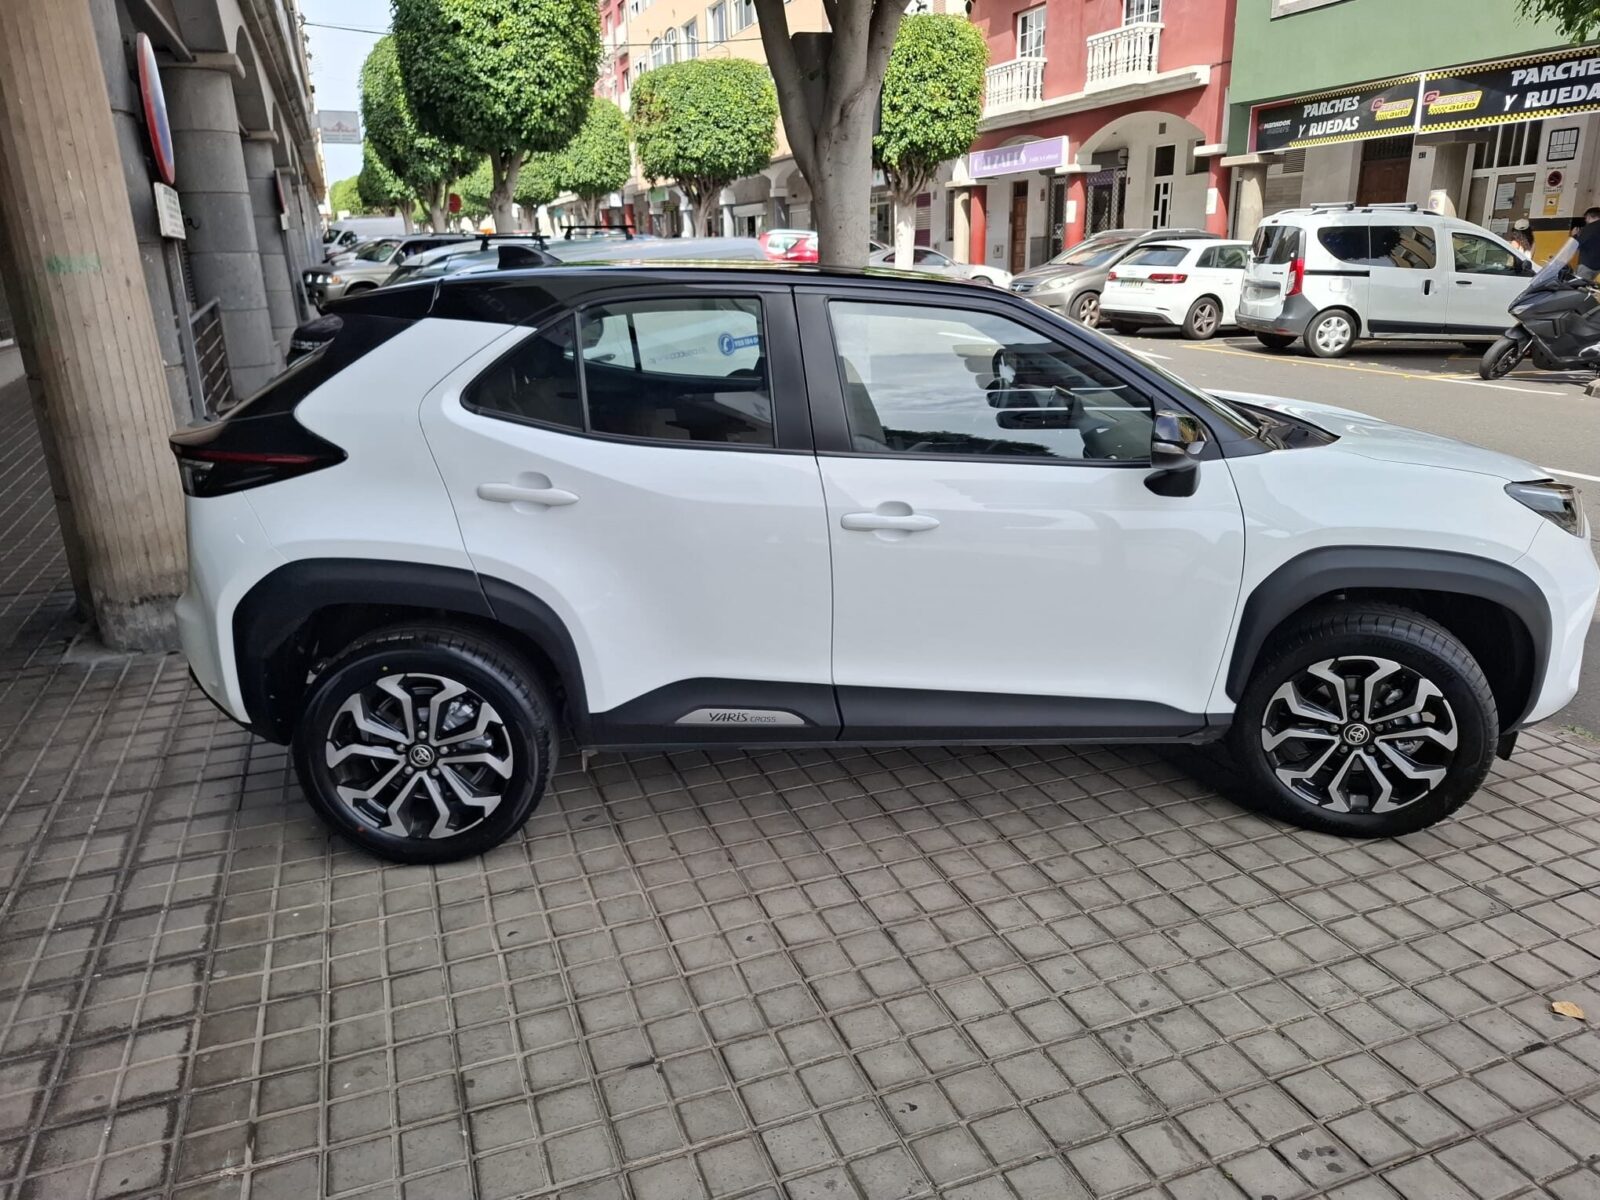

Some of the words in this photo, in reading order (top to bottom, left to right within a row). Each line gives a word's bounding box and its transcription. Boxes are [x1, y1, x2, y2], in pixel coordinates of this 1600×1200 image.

[1303, 96, 1360, 118] PARCHES
[1448, 102, 1476, 111] auto
[1503, 94, 1518, 111] Y
[1297, 124, 1307, 138] Y
[1308, 116, 1360, 134] RUEDAS
